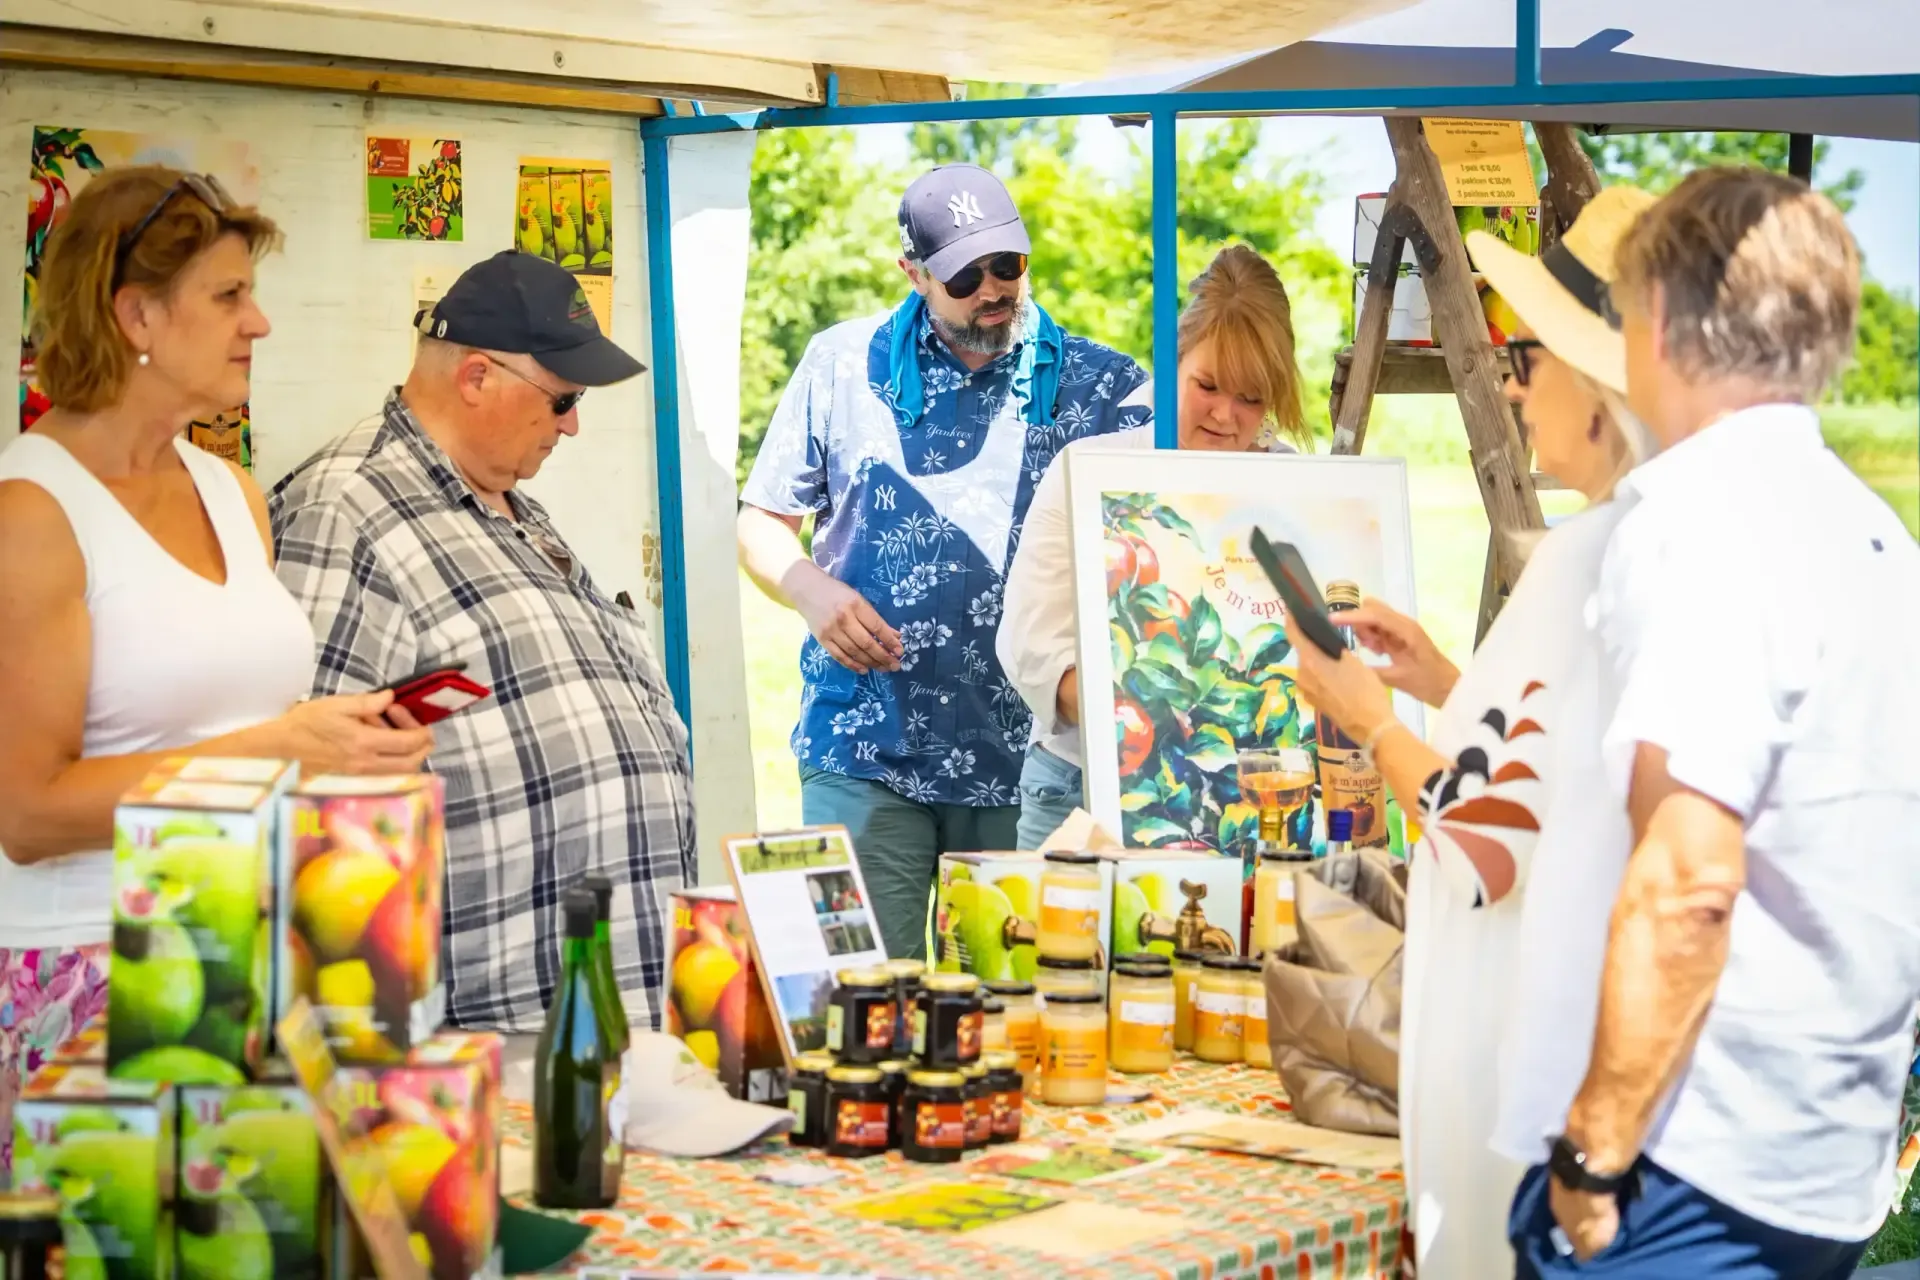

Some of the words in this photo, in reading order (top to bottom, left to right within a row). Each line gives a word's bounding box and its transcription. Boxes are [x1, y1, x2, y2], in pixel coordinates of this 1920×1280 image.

[947, 190, 984, 228] NY
[925, 423, 974, 440] Yankees
[874, 484, 897, 511] NY
[1206, 565, 1226, 590] Je
